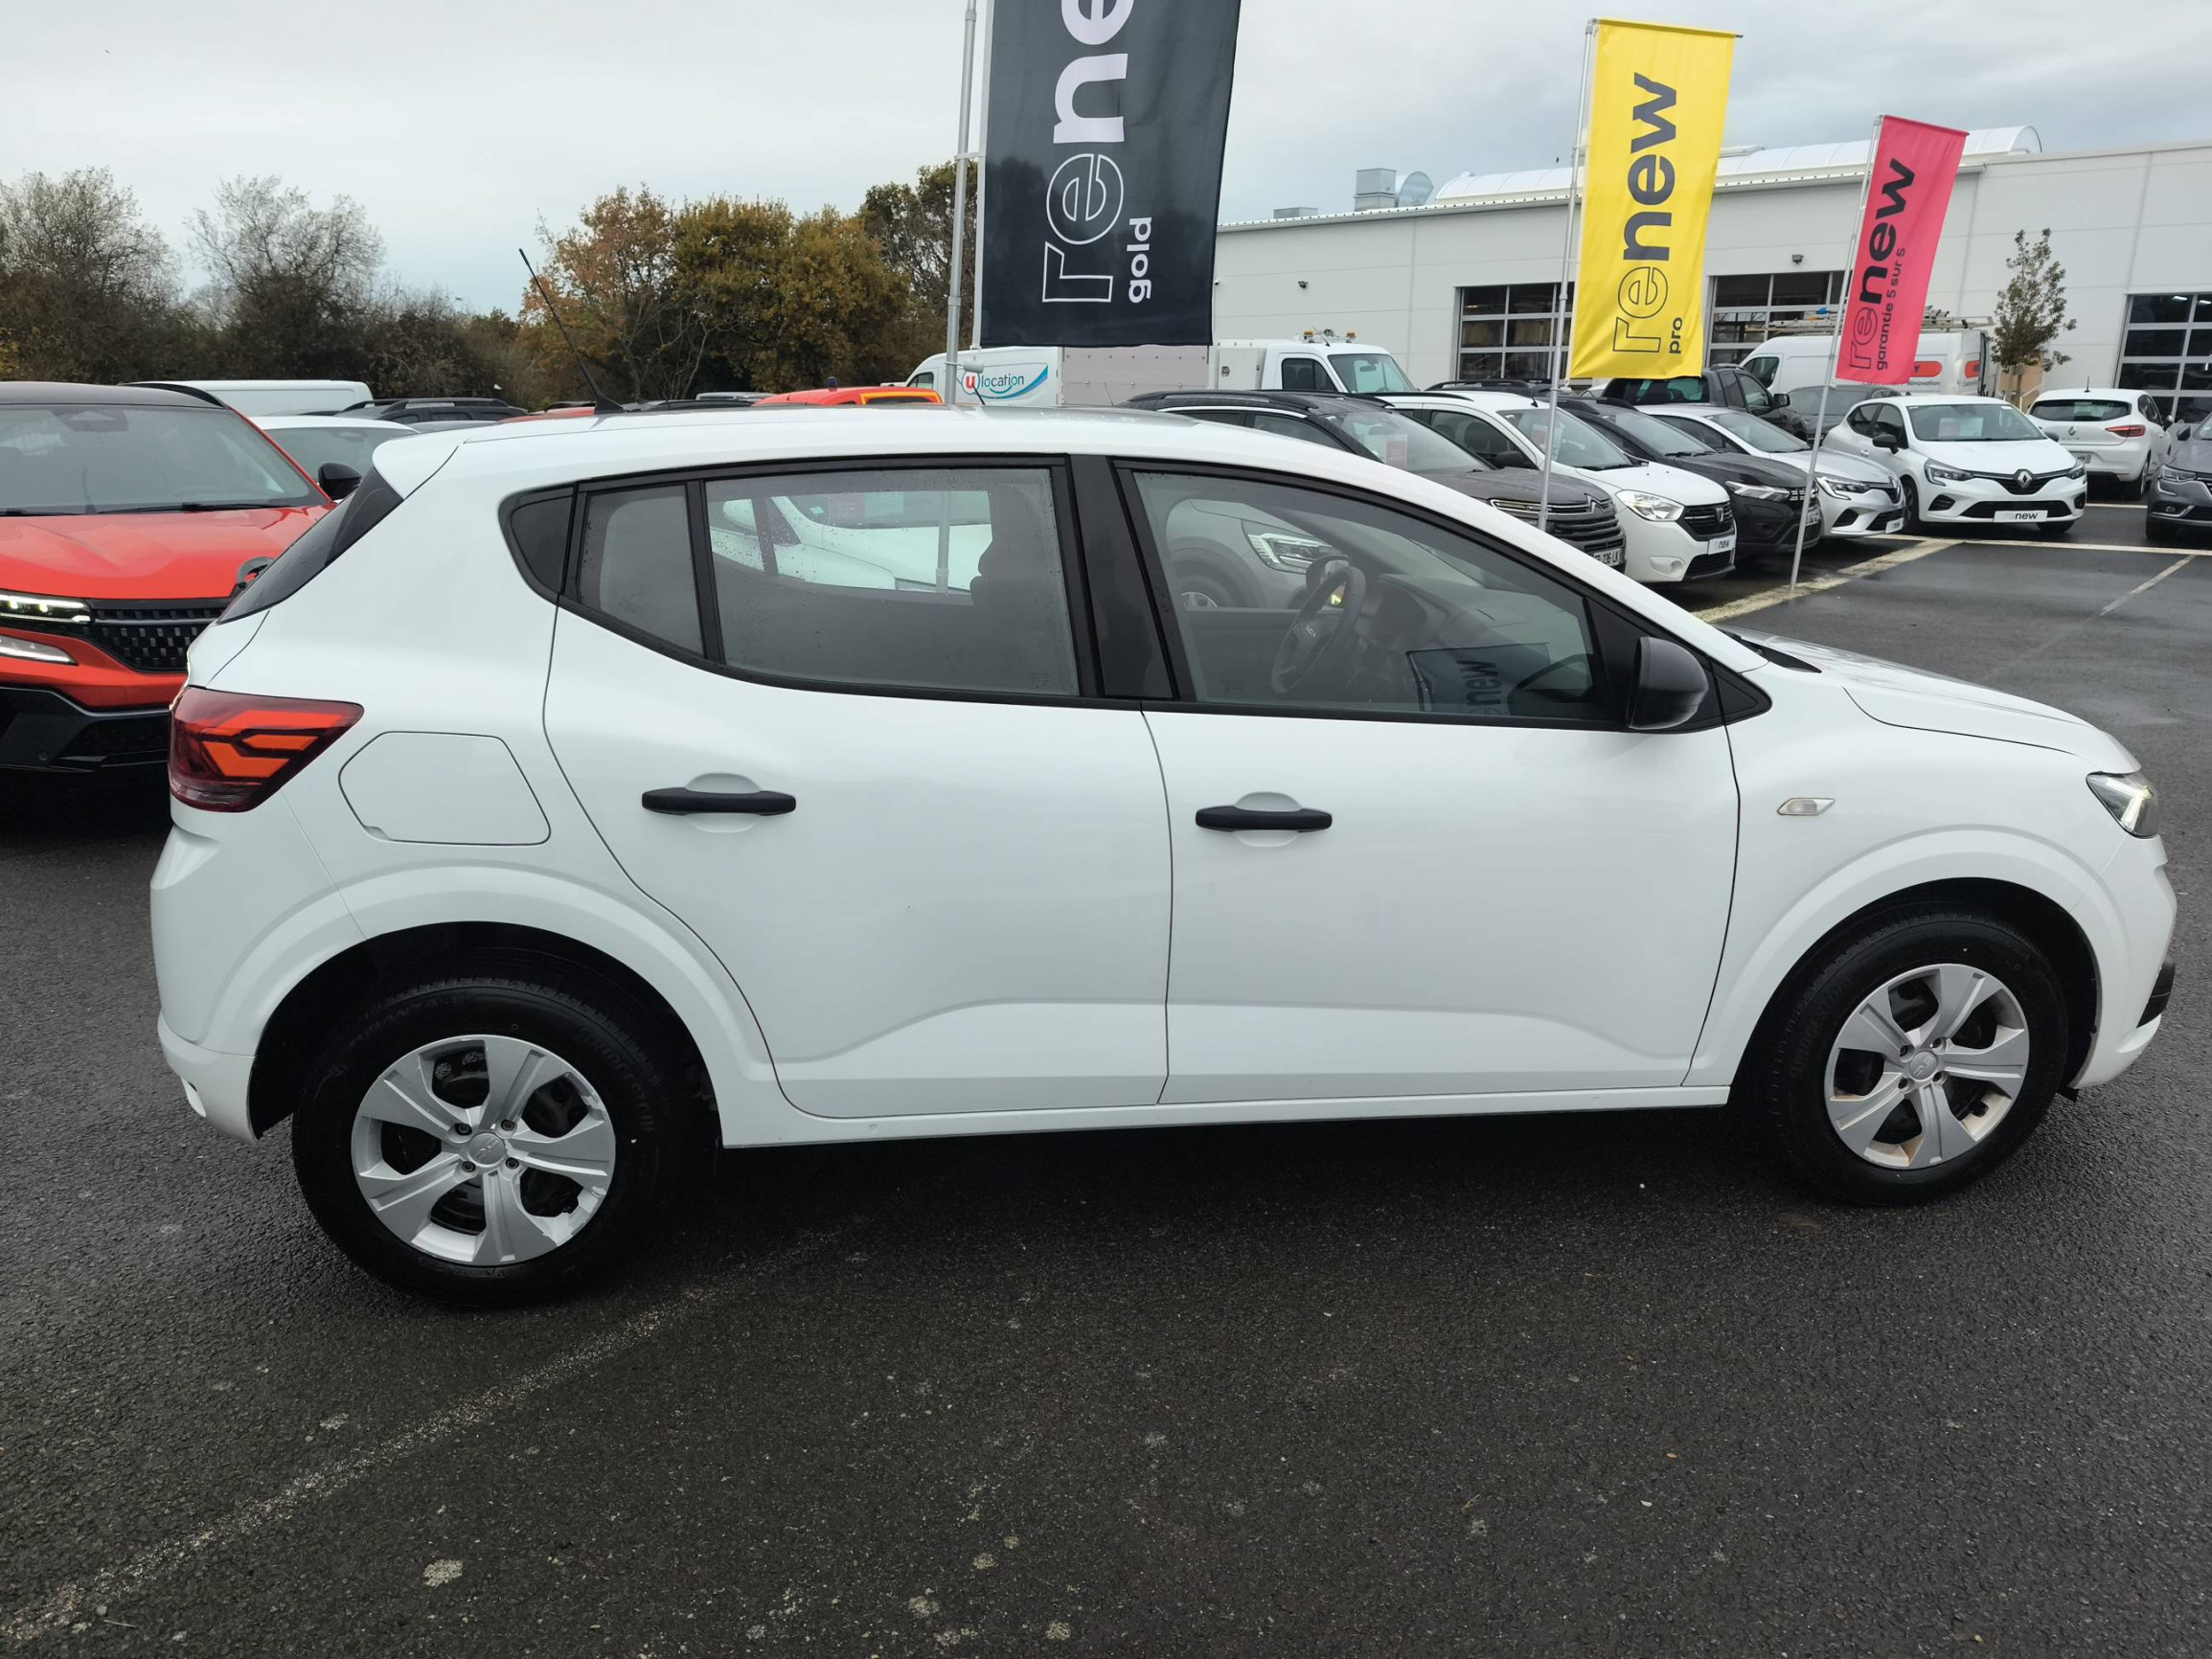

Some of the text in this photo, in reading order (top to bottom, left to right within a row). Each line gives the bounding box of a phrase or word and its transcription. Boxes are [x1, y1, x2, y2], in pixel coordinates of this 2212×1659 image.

[1042, 0, 1135, 303] rene
[1612, 72, 1676, 353] renew
[1127, 216, 1152, 303] gold
[1849, 158, 1915, 370] renew
[1877, 247, 1905, 371] garantie 5 sur 5
[981, 373, 1024, 387] location
[1668, 316, 1683, 354] pro
